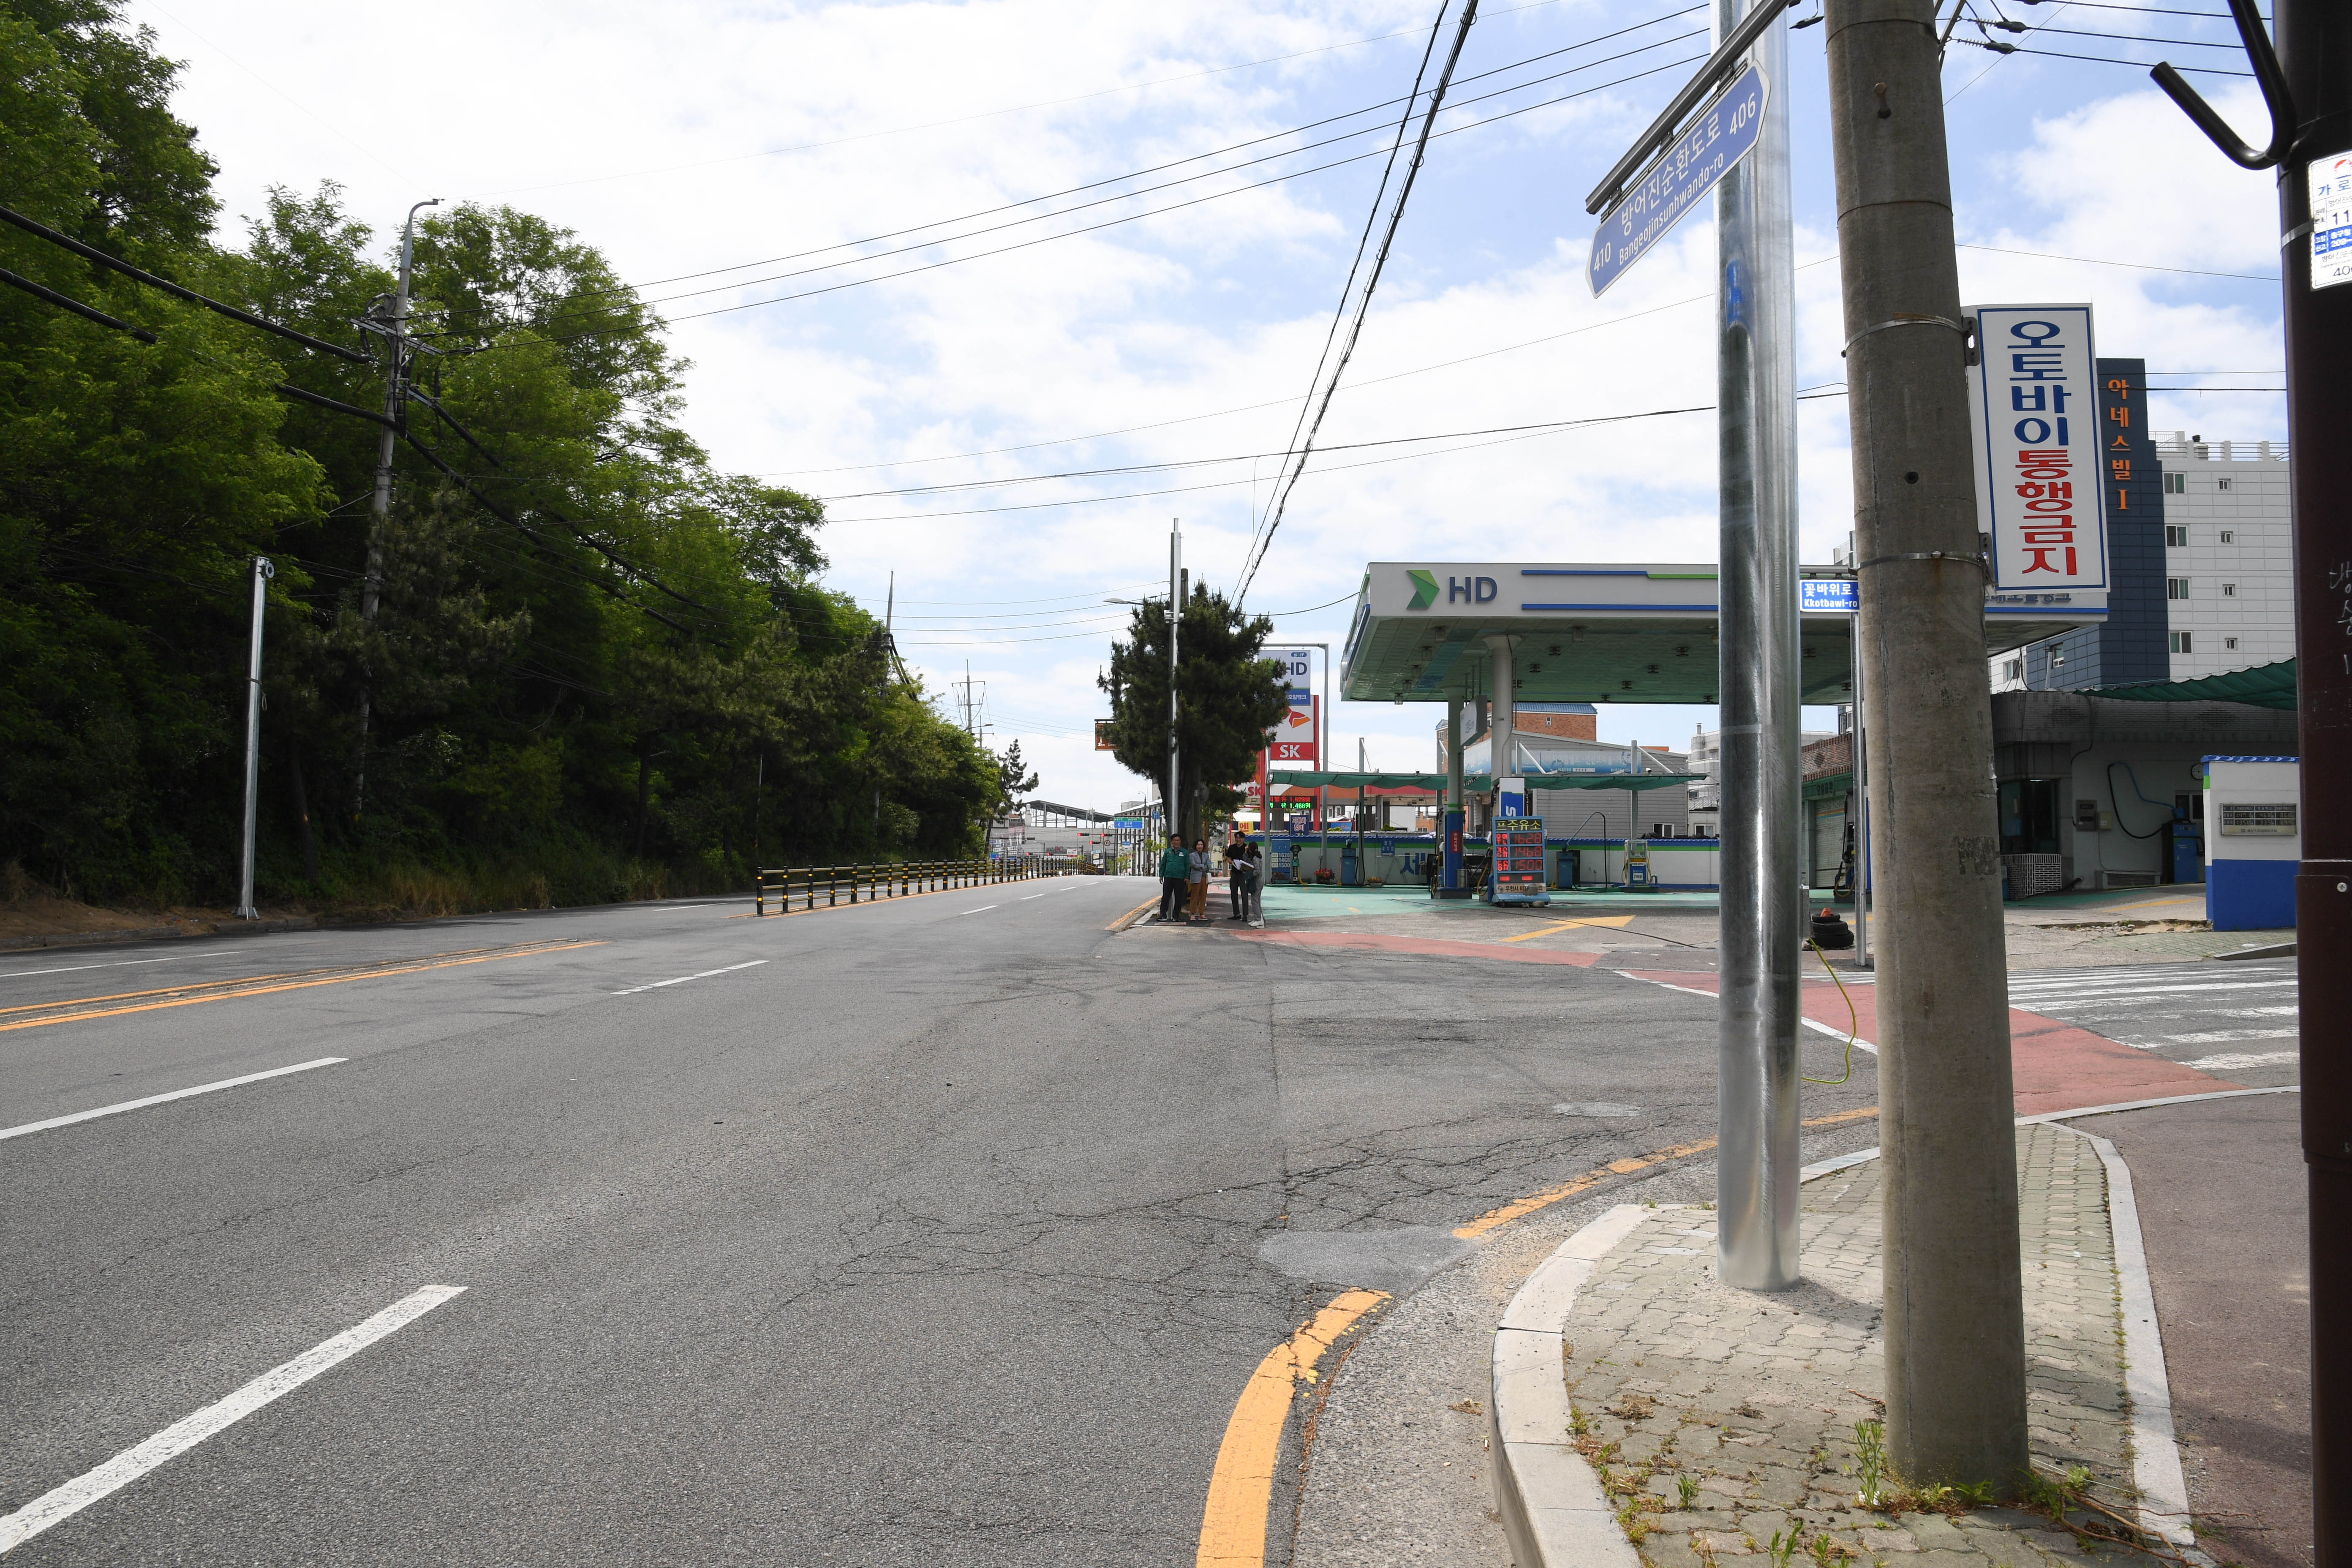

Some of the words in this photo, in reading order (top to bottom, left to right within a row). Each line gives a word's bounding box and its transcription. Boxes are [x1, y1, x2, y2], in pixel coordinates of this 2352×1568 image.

[1594, 242, 1611, 271] 410
[1621, 112, 1721, 235] 방어진순환도로
[1729, 92, 1756, 135] 406
[1619, 152, 1723, 265] Bangeojinsunhwando-ro
[2333, 265, 2352, 276] 40
[2008, 321, 2072, 446] 오토바이
[2108, 379, 2131, 480] 아네스빌
[2015, 450, 2077, 576] 통행금지
[1449, 577, 1497, 602] HD
[1804, 583, 1852, 597] 꽃바위로
[1804, 599, 1857, 607] Kkotbawi-ro
[1284, 662, 1307, 675] HD
[1279, 745, 1301, 758] SK
[1514, 833, 1542, 844] 1628
[1515, 846, 1542, 857] 1468
[1516, 860, 1542, 871] 1500
